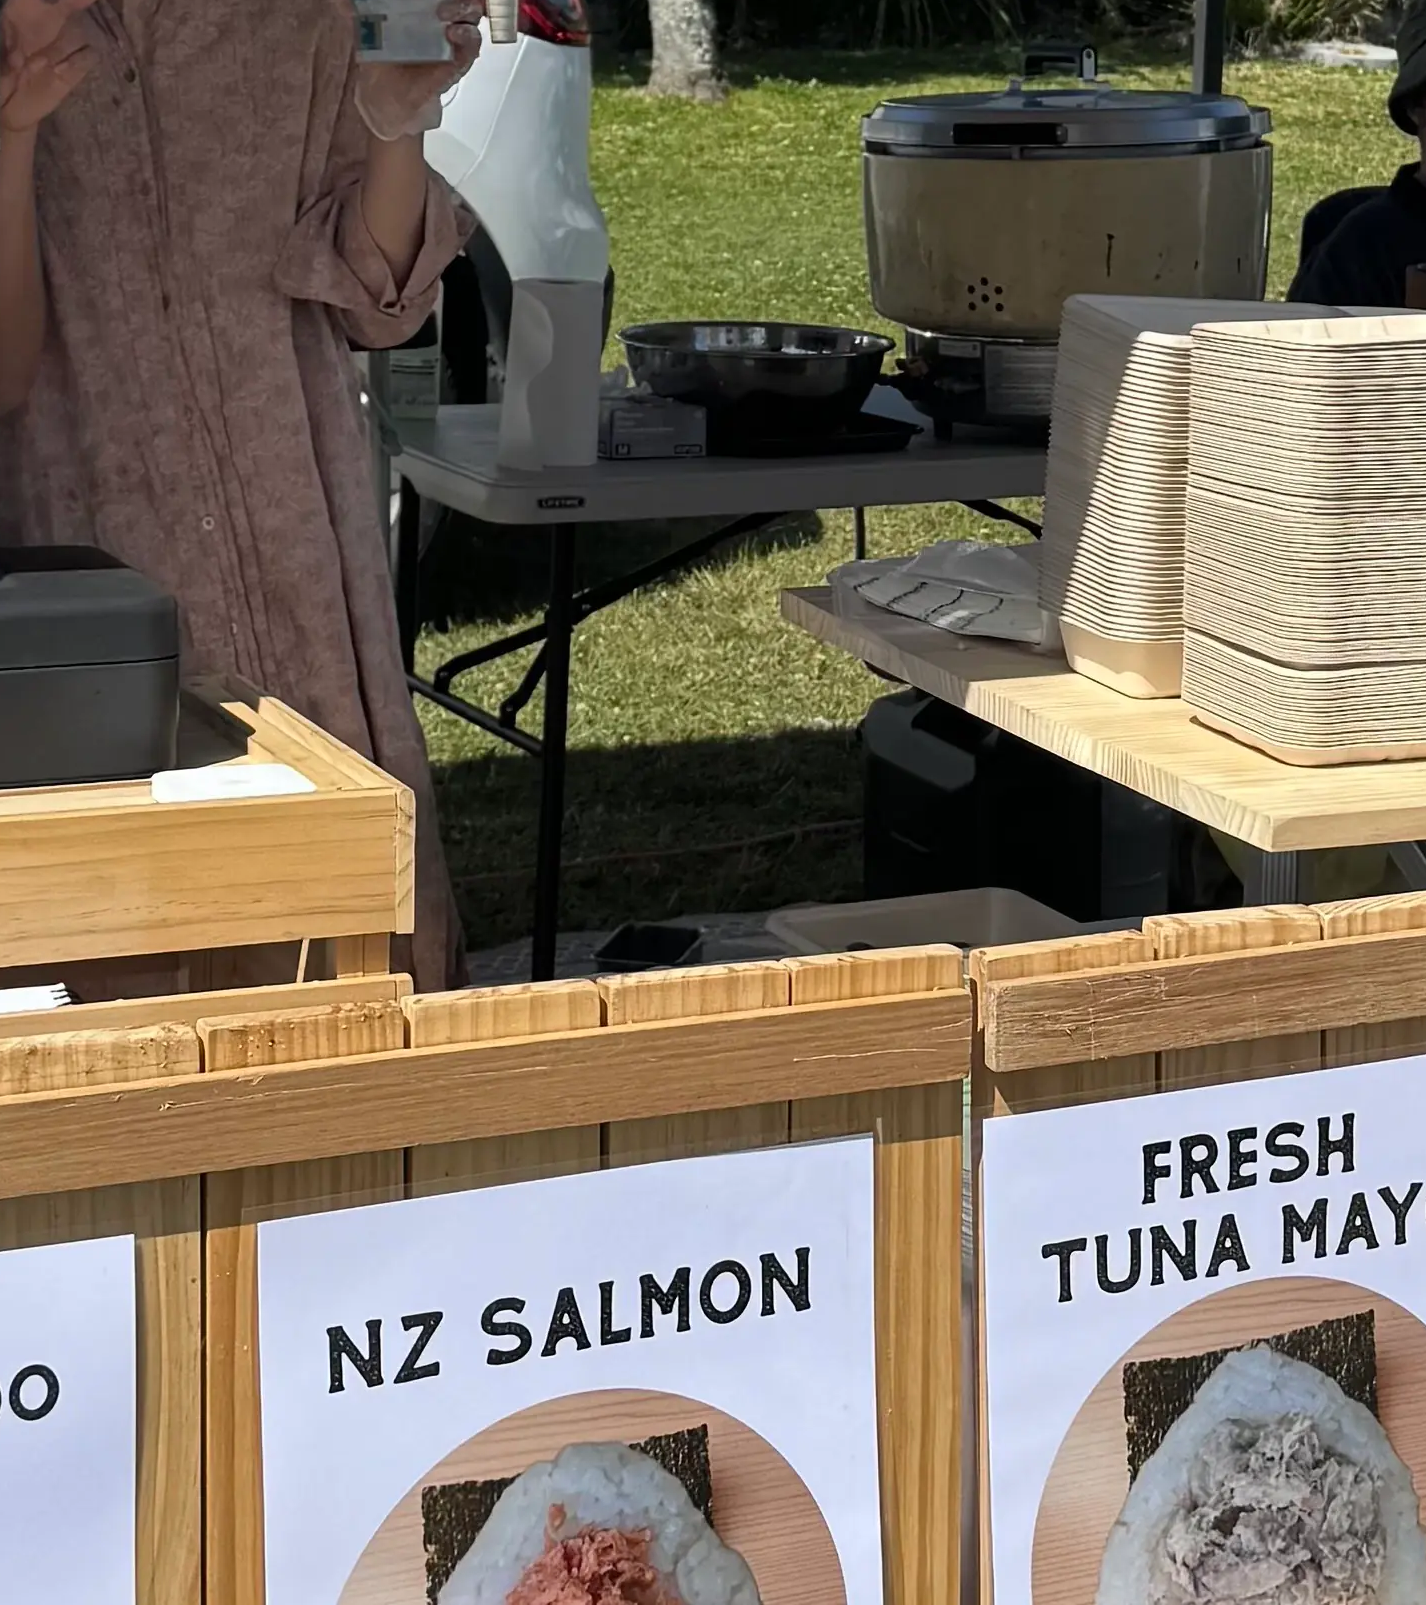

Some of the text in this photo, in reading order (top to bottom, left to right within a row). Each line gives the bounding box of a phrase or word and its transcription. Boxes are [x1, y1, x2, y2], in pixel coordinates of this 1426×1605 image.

[1141, 1113, 1355, 1205] FRESH
[1042, 1214, 1251, 1303] TUNA
[327, 1247, 811, 1393] NZ SALMON
